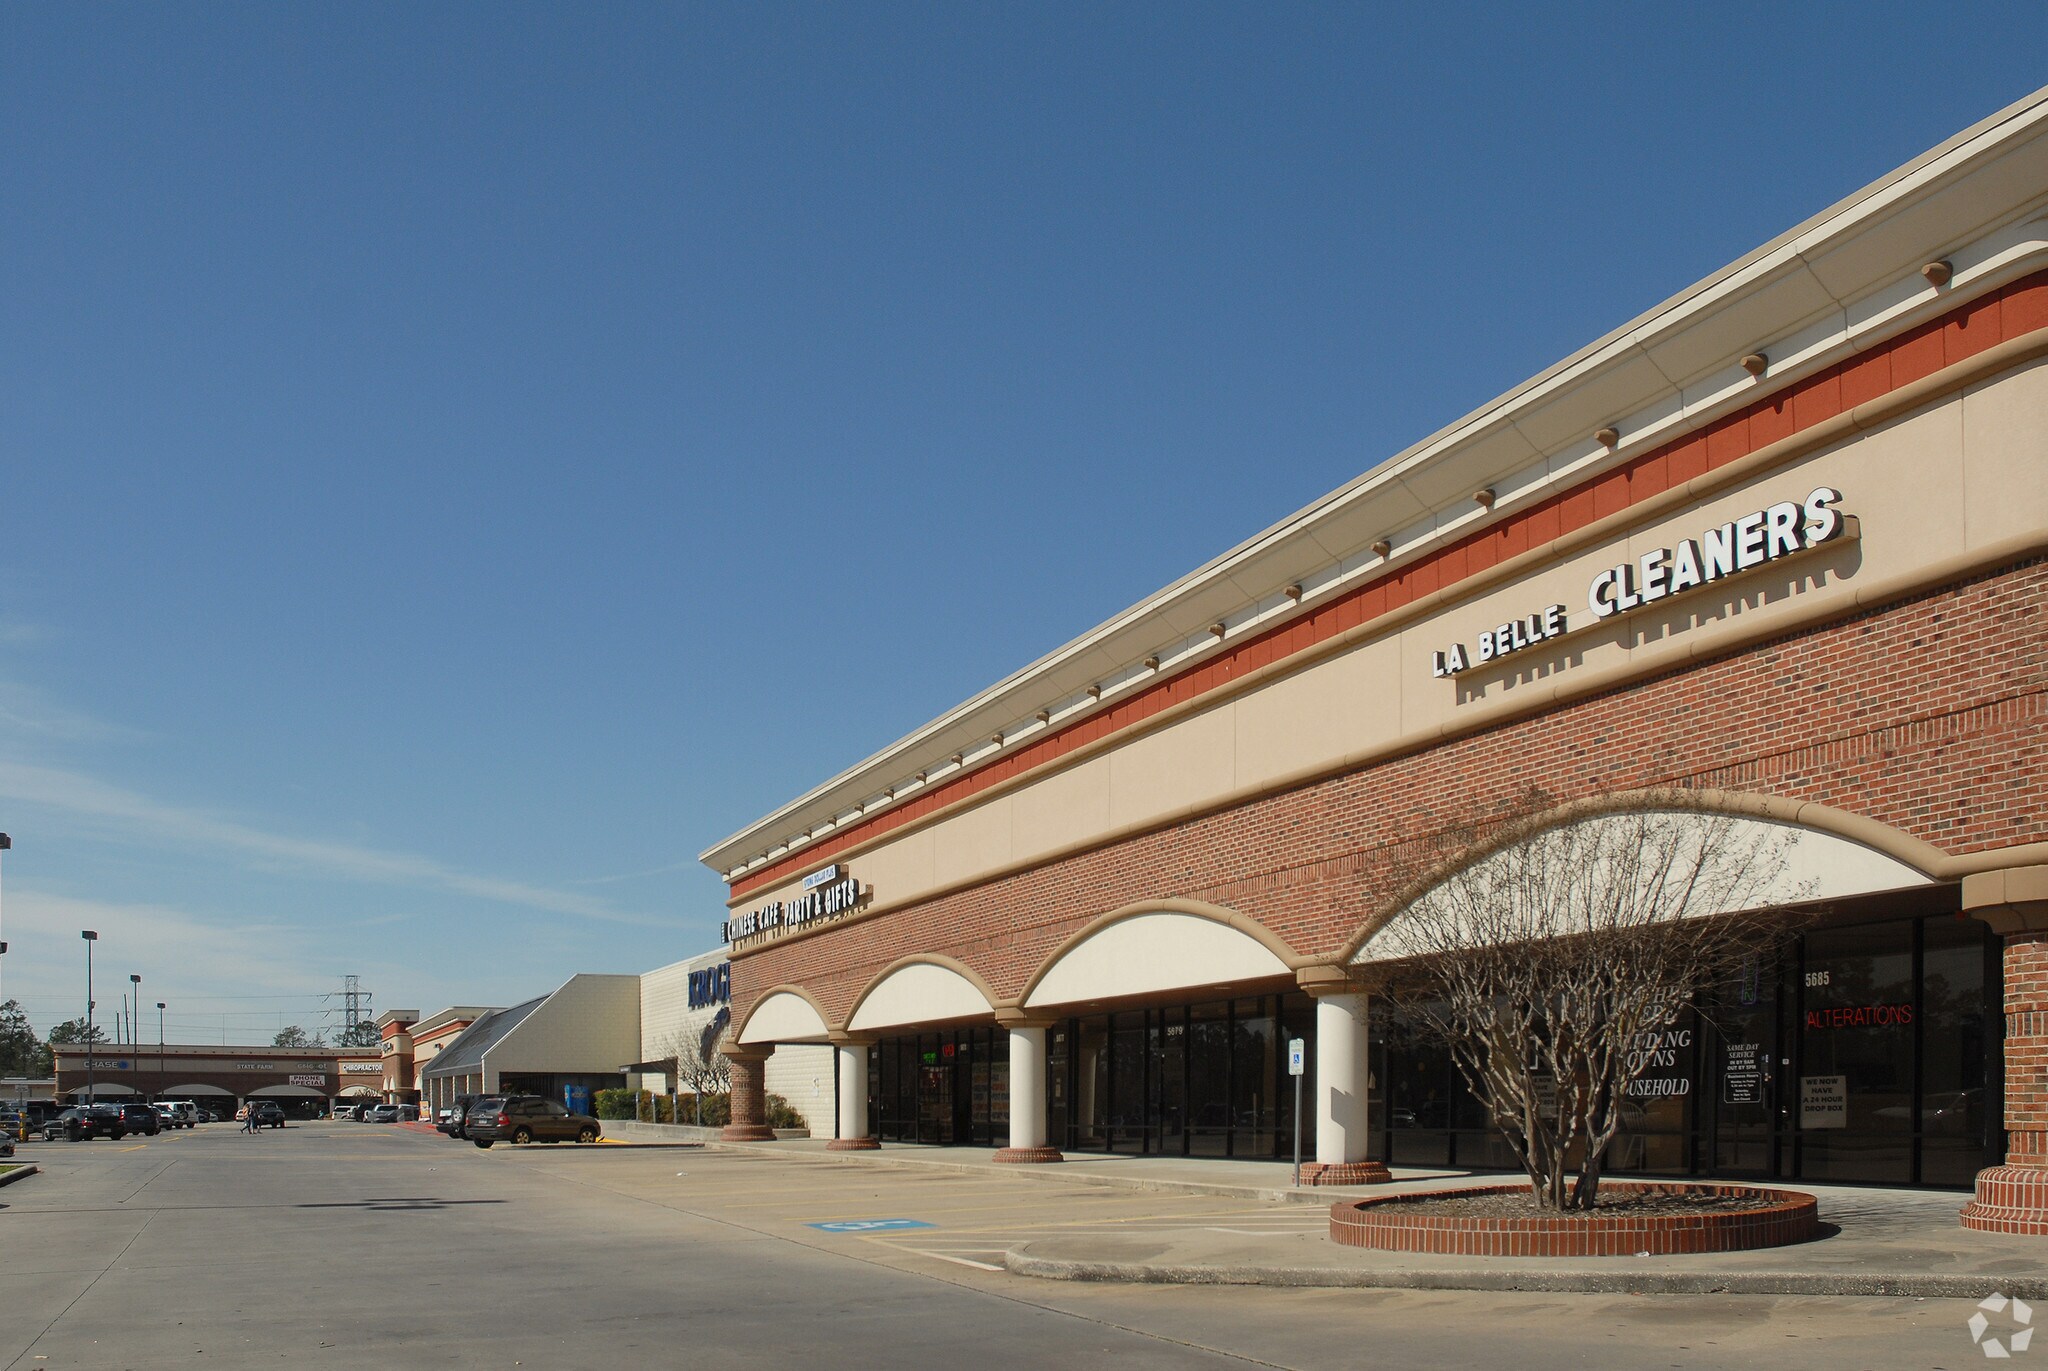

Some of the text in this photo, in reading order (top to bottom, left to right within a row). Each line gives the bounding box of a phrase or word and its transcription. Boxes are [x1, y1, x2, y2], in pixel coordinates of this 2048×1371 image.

[1432, 487, 1840, 678] LA BELLE CLEANERS
[727, 911, 757, 942] CHINESE
[759, 902, 779, 929] CAFE
[784, 894, 812, 927] PARTY
[814, 892, 821, 915] &
[825, 879, 855, 914] GIFTS
[688, 962, 730, 1008] KROG
[1805, 971, 1830, 987] 5685
[1807, 1005, 1912, 1031] ALTERATIONS
[343, 1063, 383, 1071] CHIROPRACTOR
[1625, 1050, 1676, 1069] OWNS
[1626, 1079, 1689, 1096] USEHOLD
